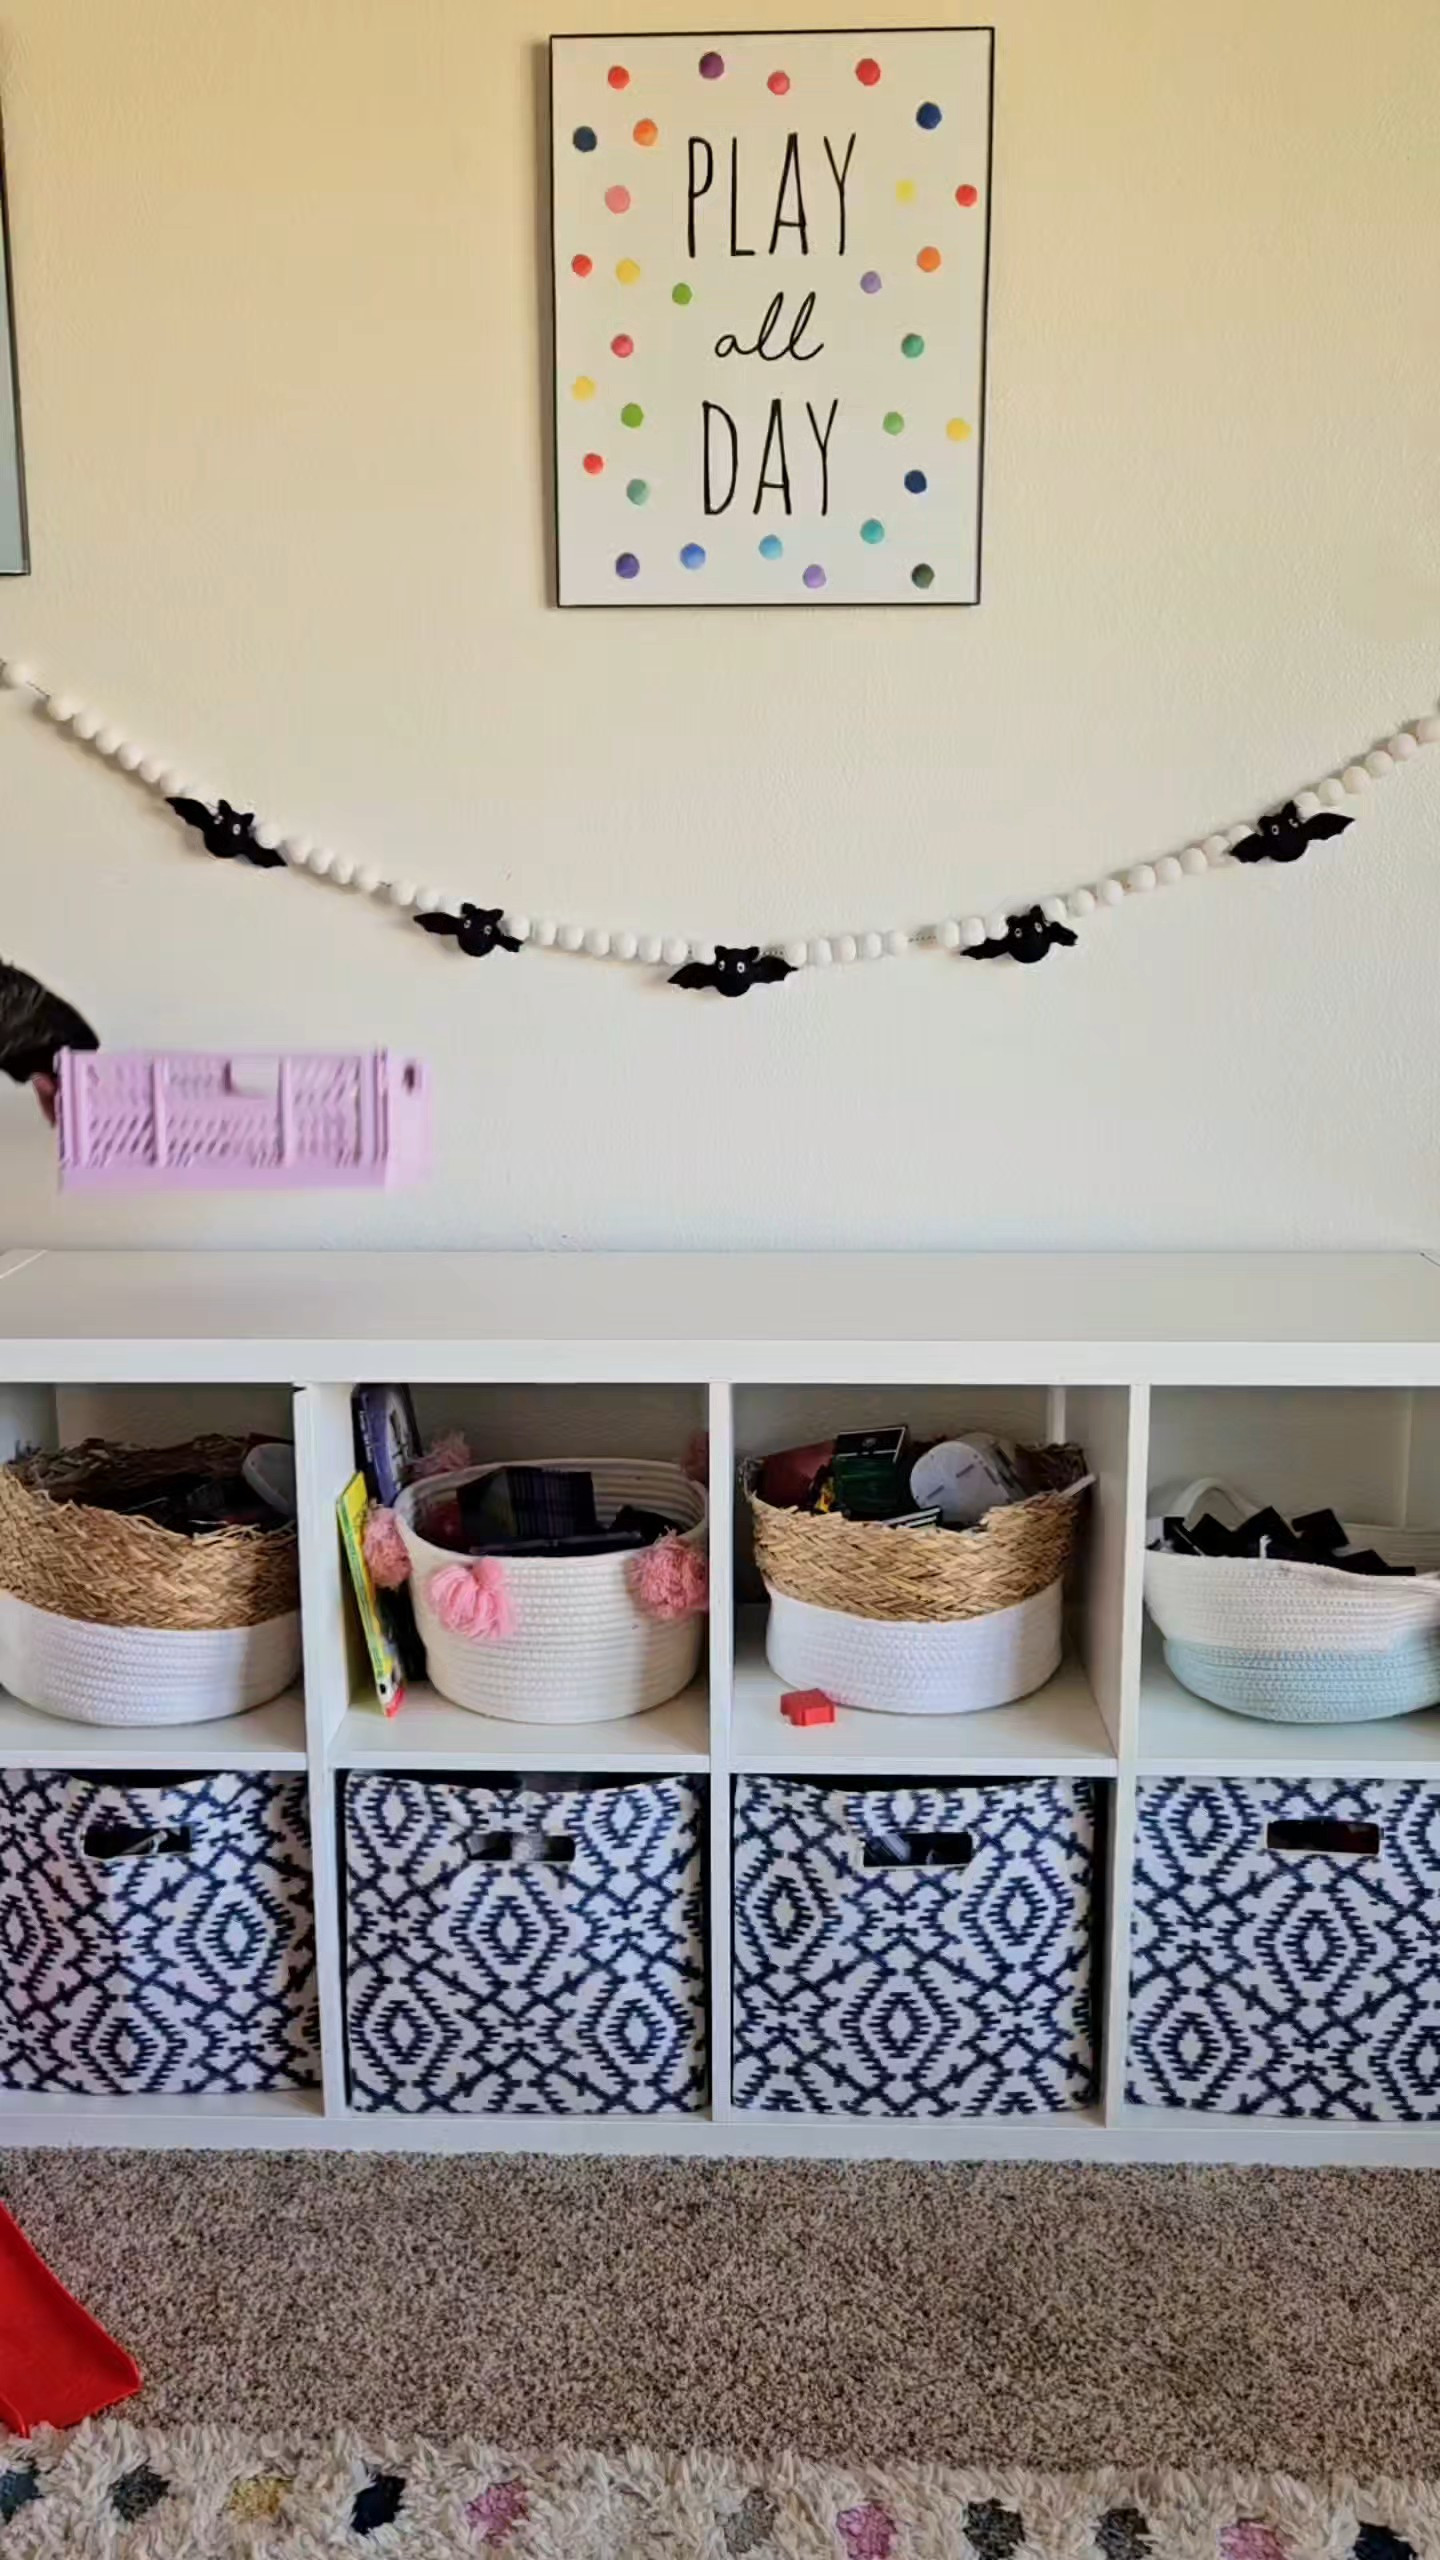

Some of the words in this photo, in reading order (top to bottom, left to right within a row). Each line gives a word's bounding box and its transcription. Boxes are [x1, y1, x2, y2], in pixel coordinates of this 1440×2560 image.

[688, 133, 856, 258] PLAY
[715, 292, 824, 361] all
[702, 399, 838, 516] DAY
